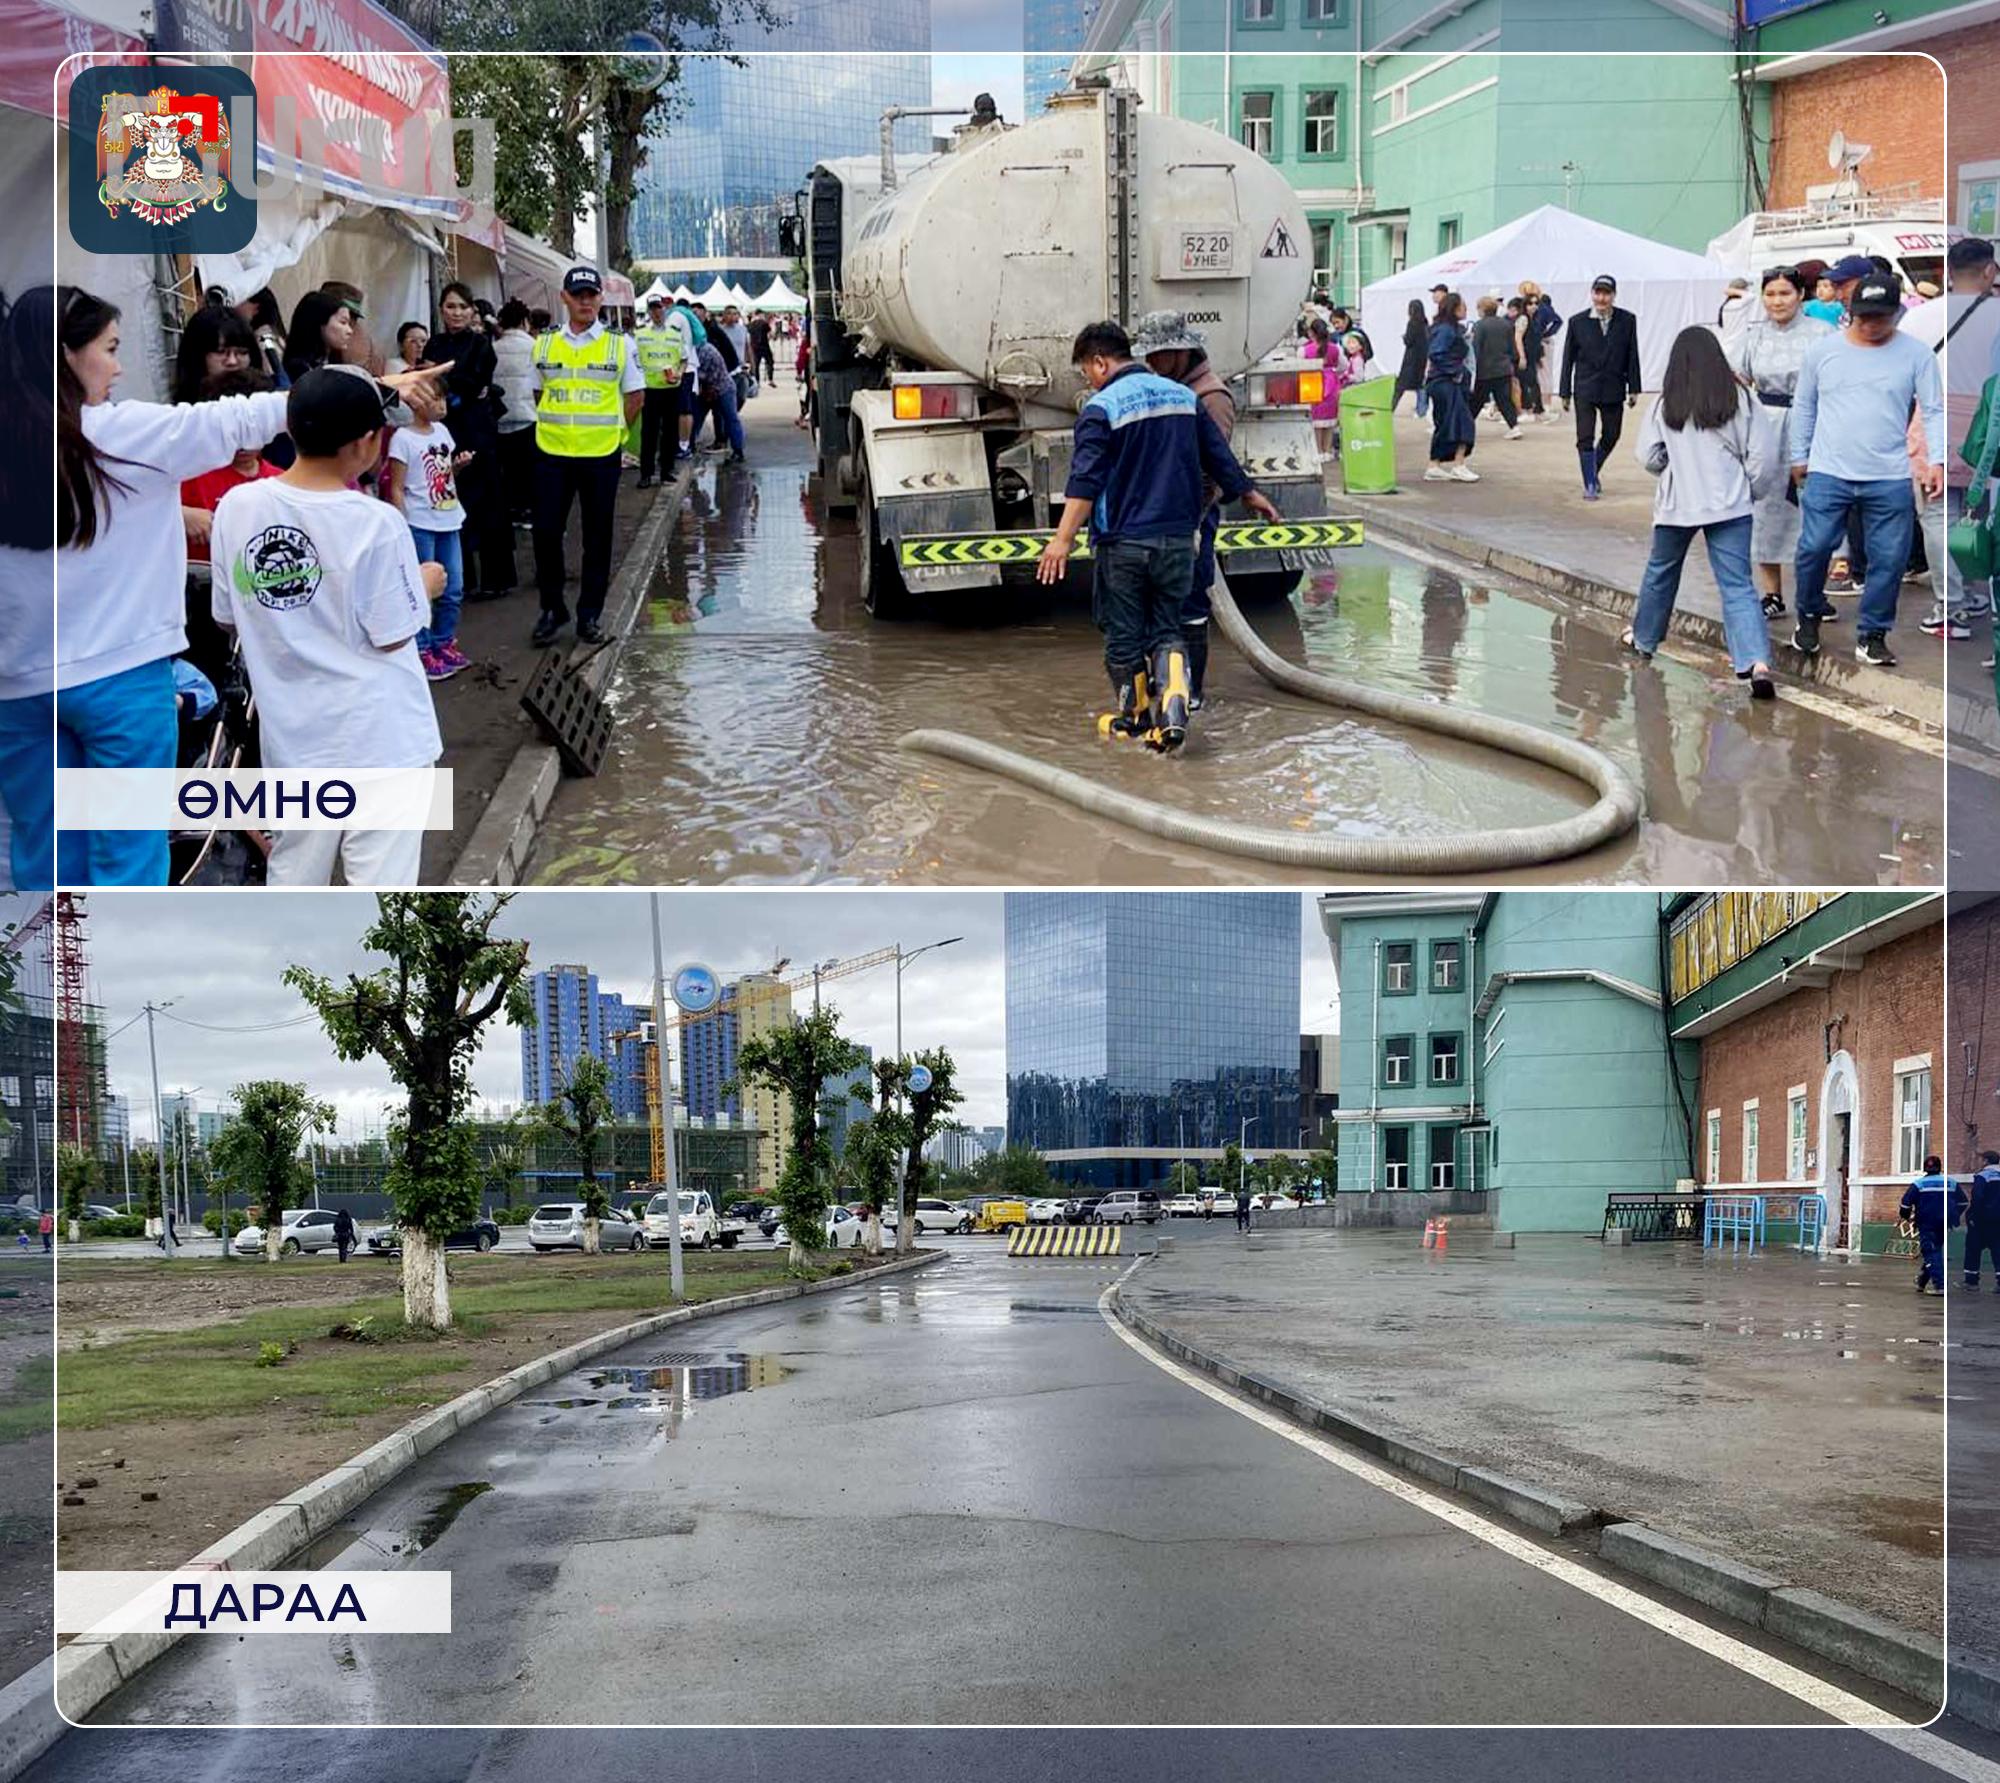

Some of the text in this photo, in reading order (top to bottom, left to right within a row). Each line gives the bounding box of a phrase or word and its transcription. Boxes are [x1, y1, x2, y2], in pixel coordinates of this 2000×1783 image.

[1186, 236, 1229, 253] 52 20
[571, 271, 598, 283] POLICE
[647, 351, 672, 360] POLICE
[548, 388, 602, 403] POLICE
[267, 528, 310, 550] NIKE
